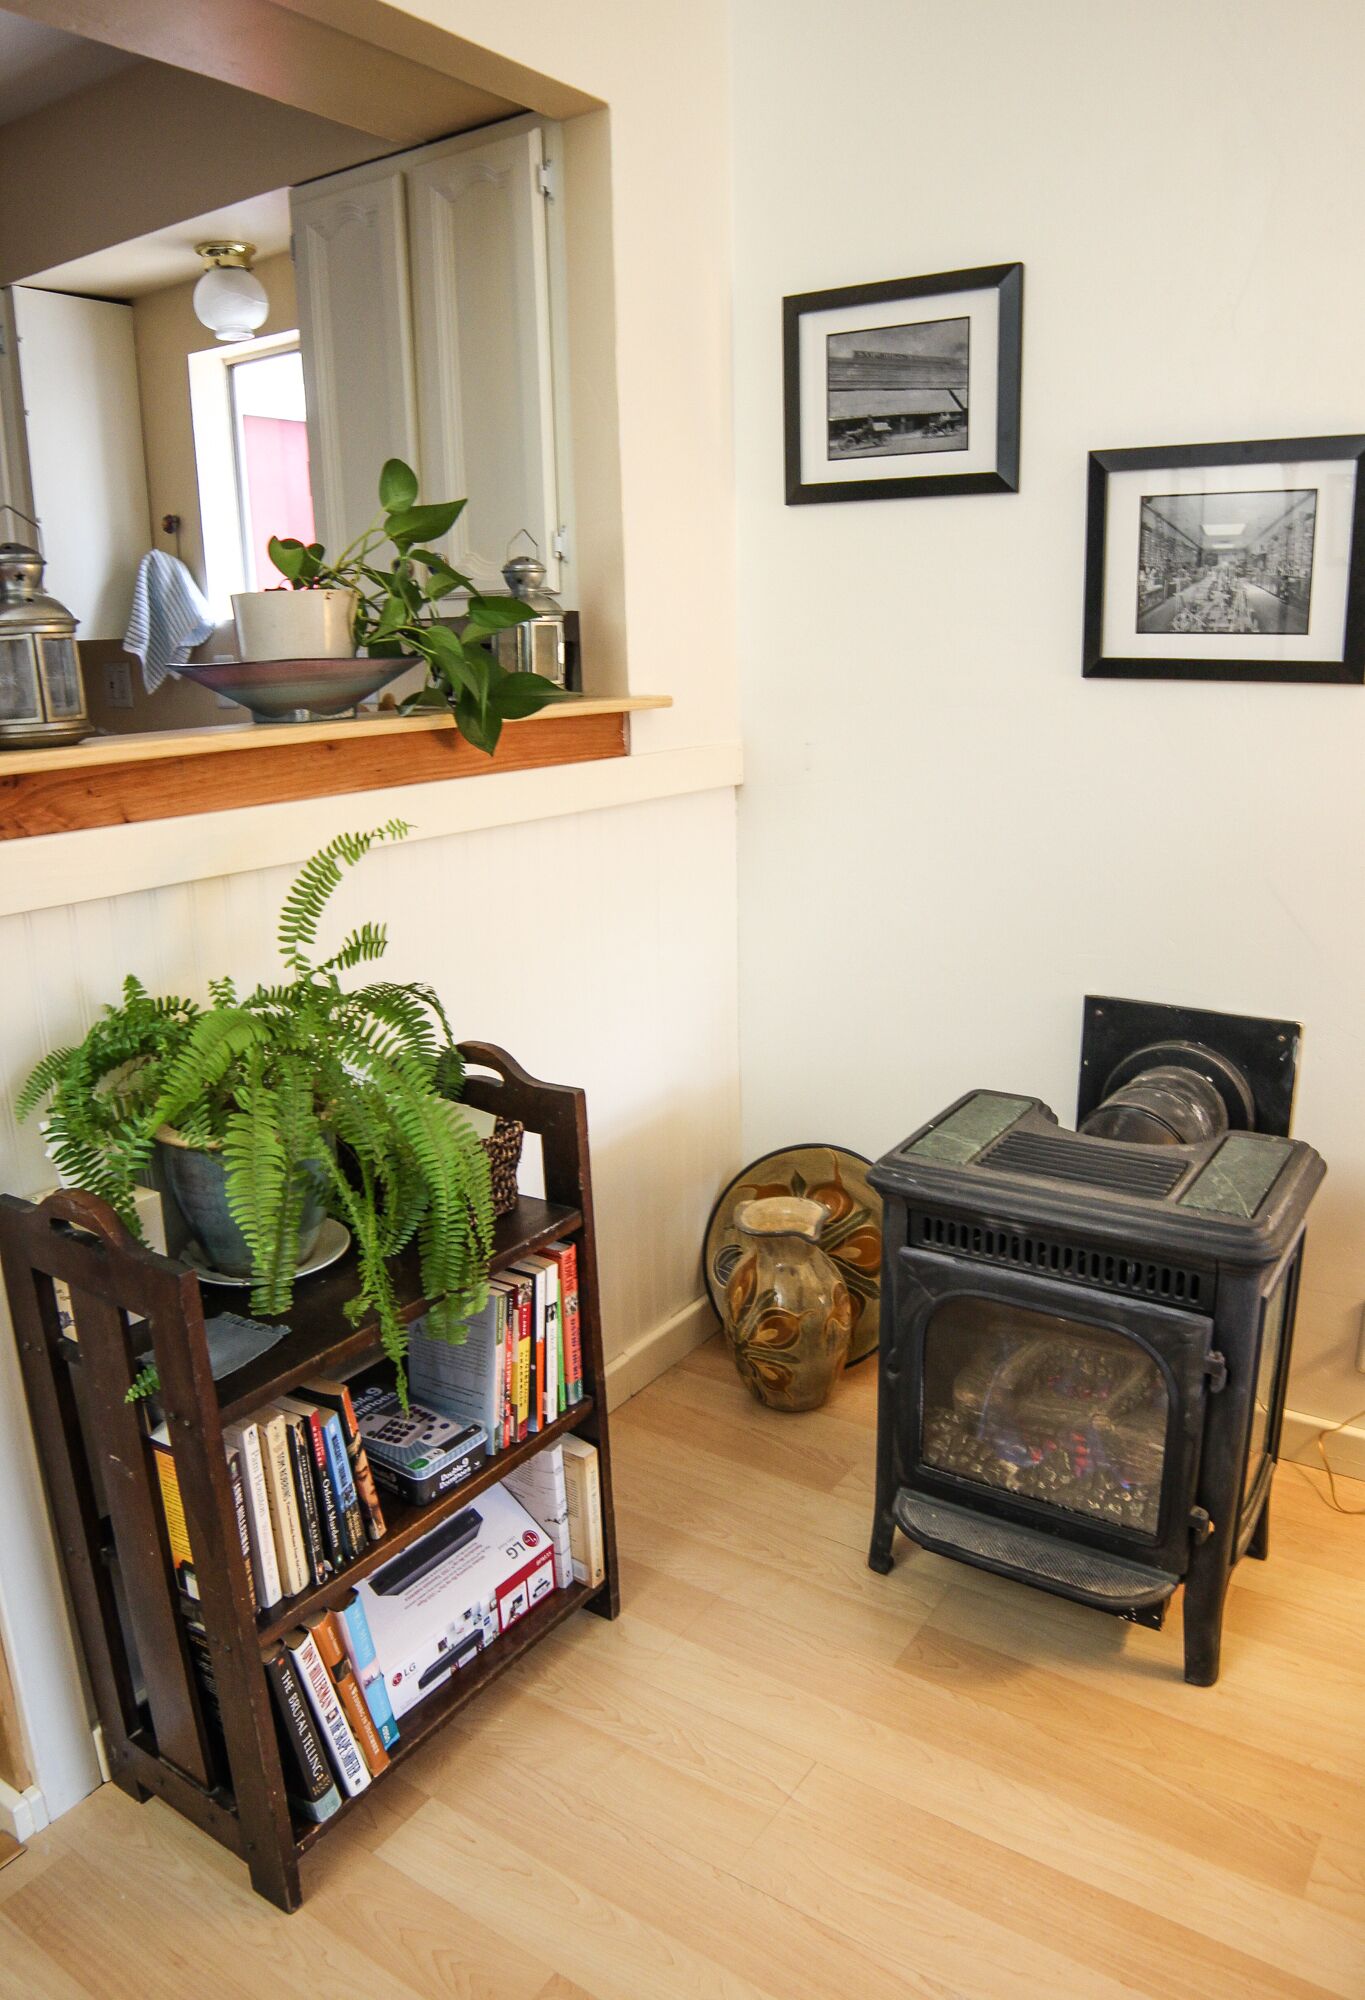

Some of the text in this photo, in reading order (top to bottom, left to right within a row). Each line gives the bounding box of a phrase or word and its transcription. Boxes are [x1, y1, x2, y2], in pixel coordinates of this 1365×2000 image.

[323, 1478, 335, 1511] Oxford
[328, 1510, 340, 1548] Murders
[505, 1541, 526, 1560] LG
[301, 1642, 332, 1711] TONY HILLERMAN
[403, 1662, 417, 1677] LG
[281, 1669, 323, 1778] THE BRUTAL TELLING
[329, 1716, 361, 1779] THE SHAPE SHIFTER
